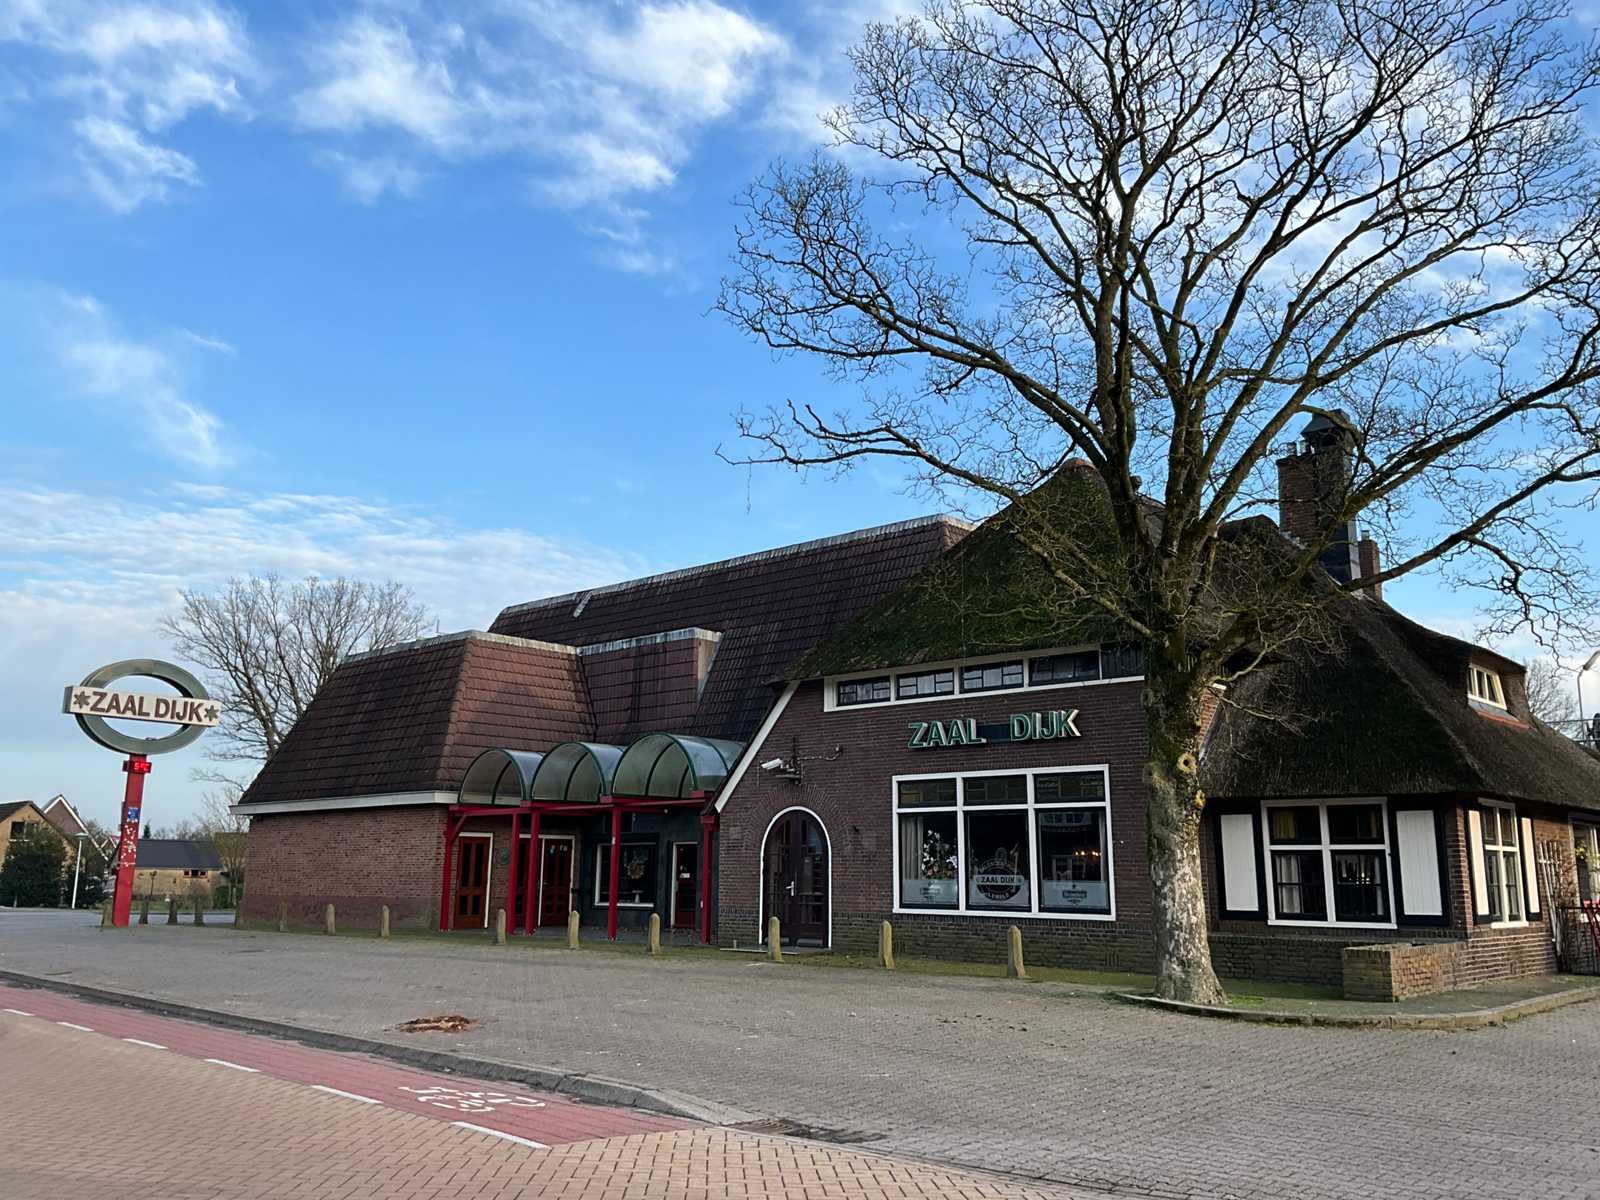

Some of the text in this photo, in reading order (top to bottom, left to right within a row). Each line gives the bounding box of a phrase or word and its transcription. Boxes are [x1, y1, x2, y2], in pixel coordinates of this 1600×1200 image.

[90, 691, 204, 722] ZAAL DIJK
[908, 709, 1082, 748] ZAAL DIJK
[981, 876, 1016, 884] ZAAL DIJK
